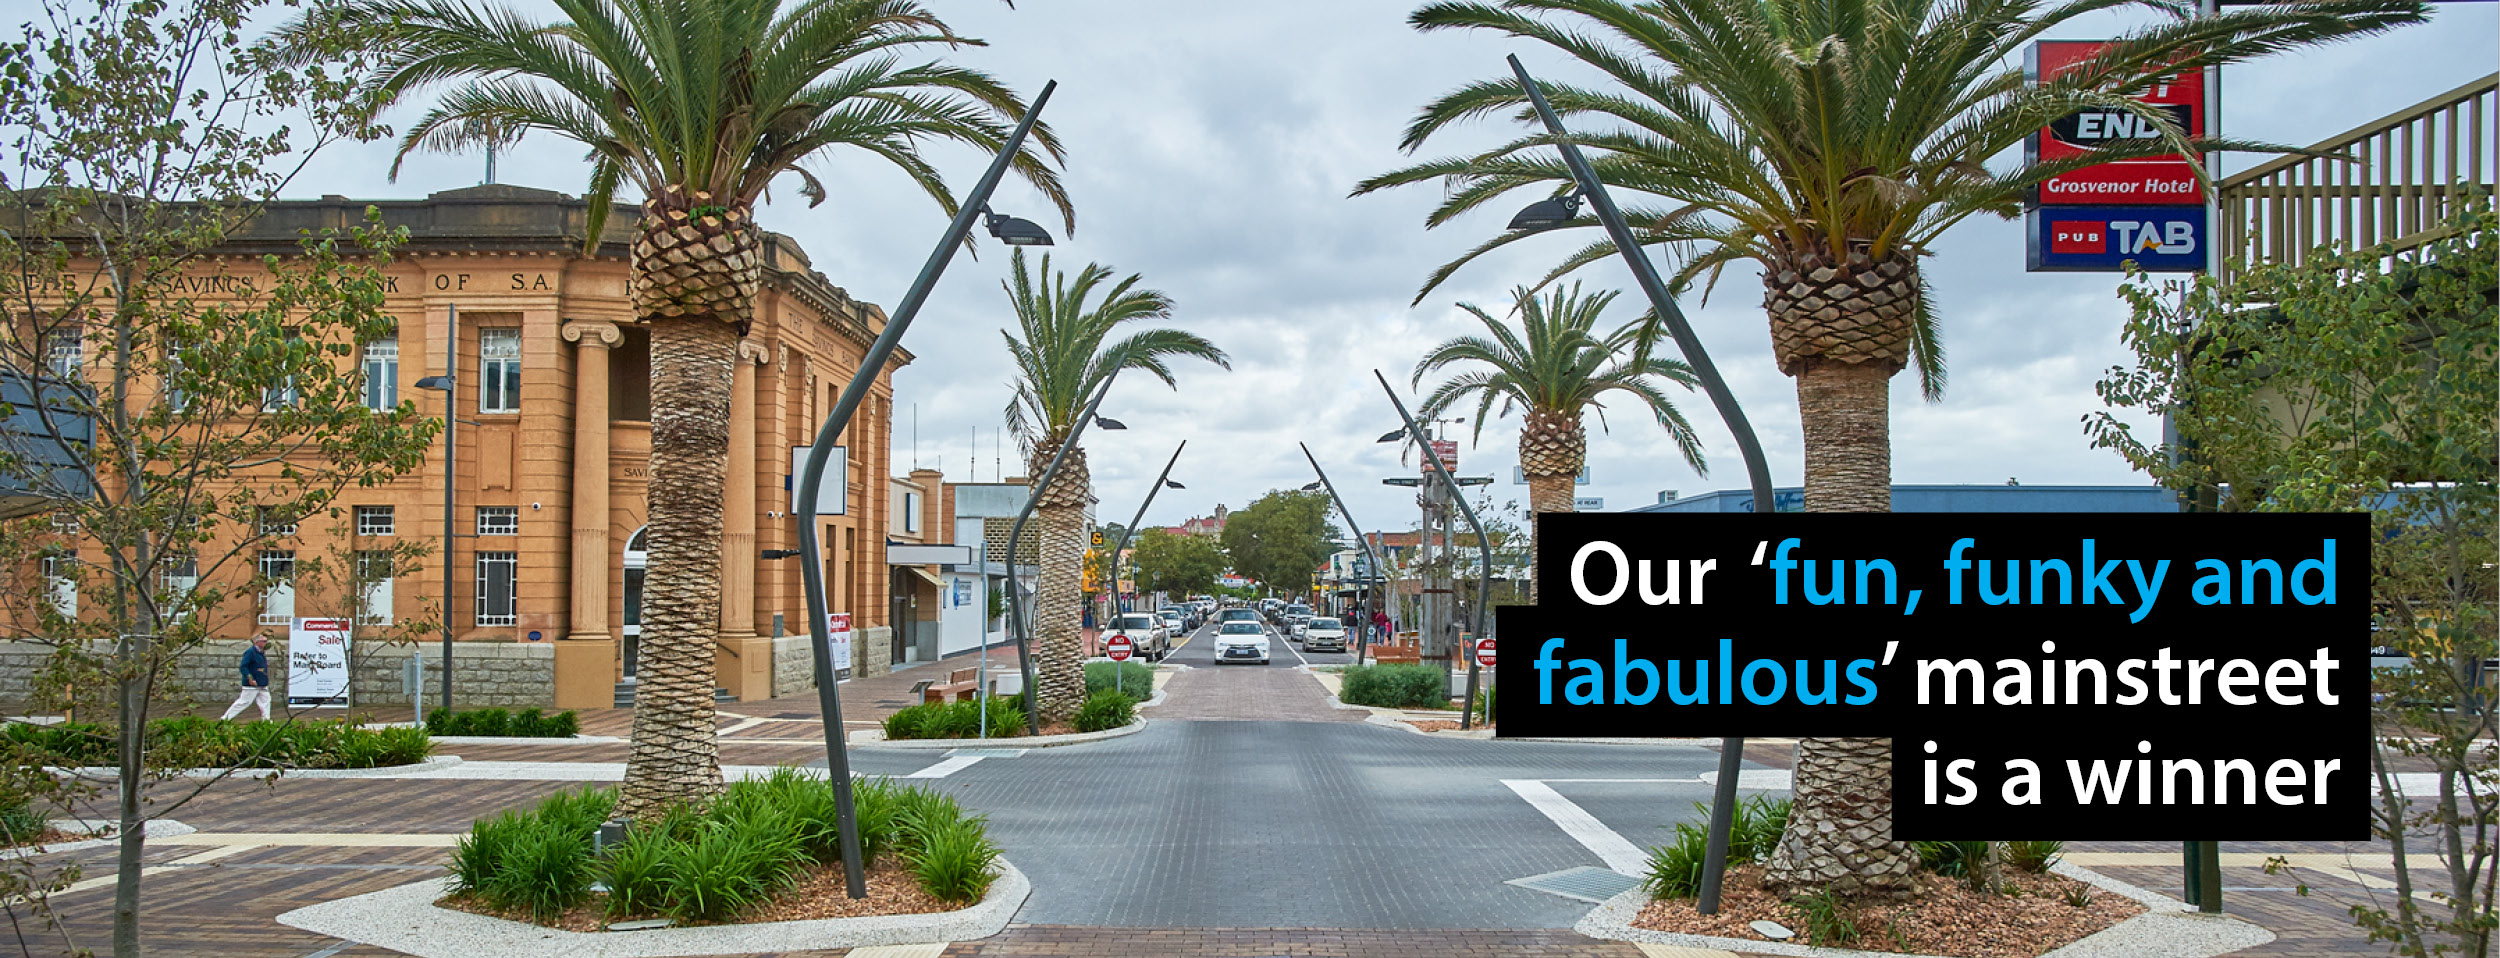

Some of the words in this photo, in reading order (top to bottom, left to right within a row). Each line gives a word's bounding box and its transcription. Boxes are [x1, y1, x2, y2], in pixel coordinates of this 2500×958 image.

[2077, 112, 2166, 139] END
[2048, 178, 2138, 193] Grosvenor
[2144, 178, 2195, 193] Hotel
[2058, 233, 2099, 242] PUB
[2109, 220, 2196, 254] TAB
[435, 274, 470, 290] OF
[511, 273, 552, 291] S.A.
[624, 467, 648, 477] SAVI
[318, 634, 342, 645] Sale
[318, 652, 328, 660] to
